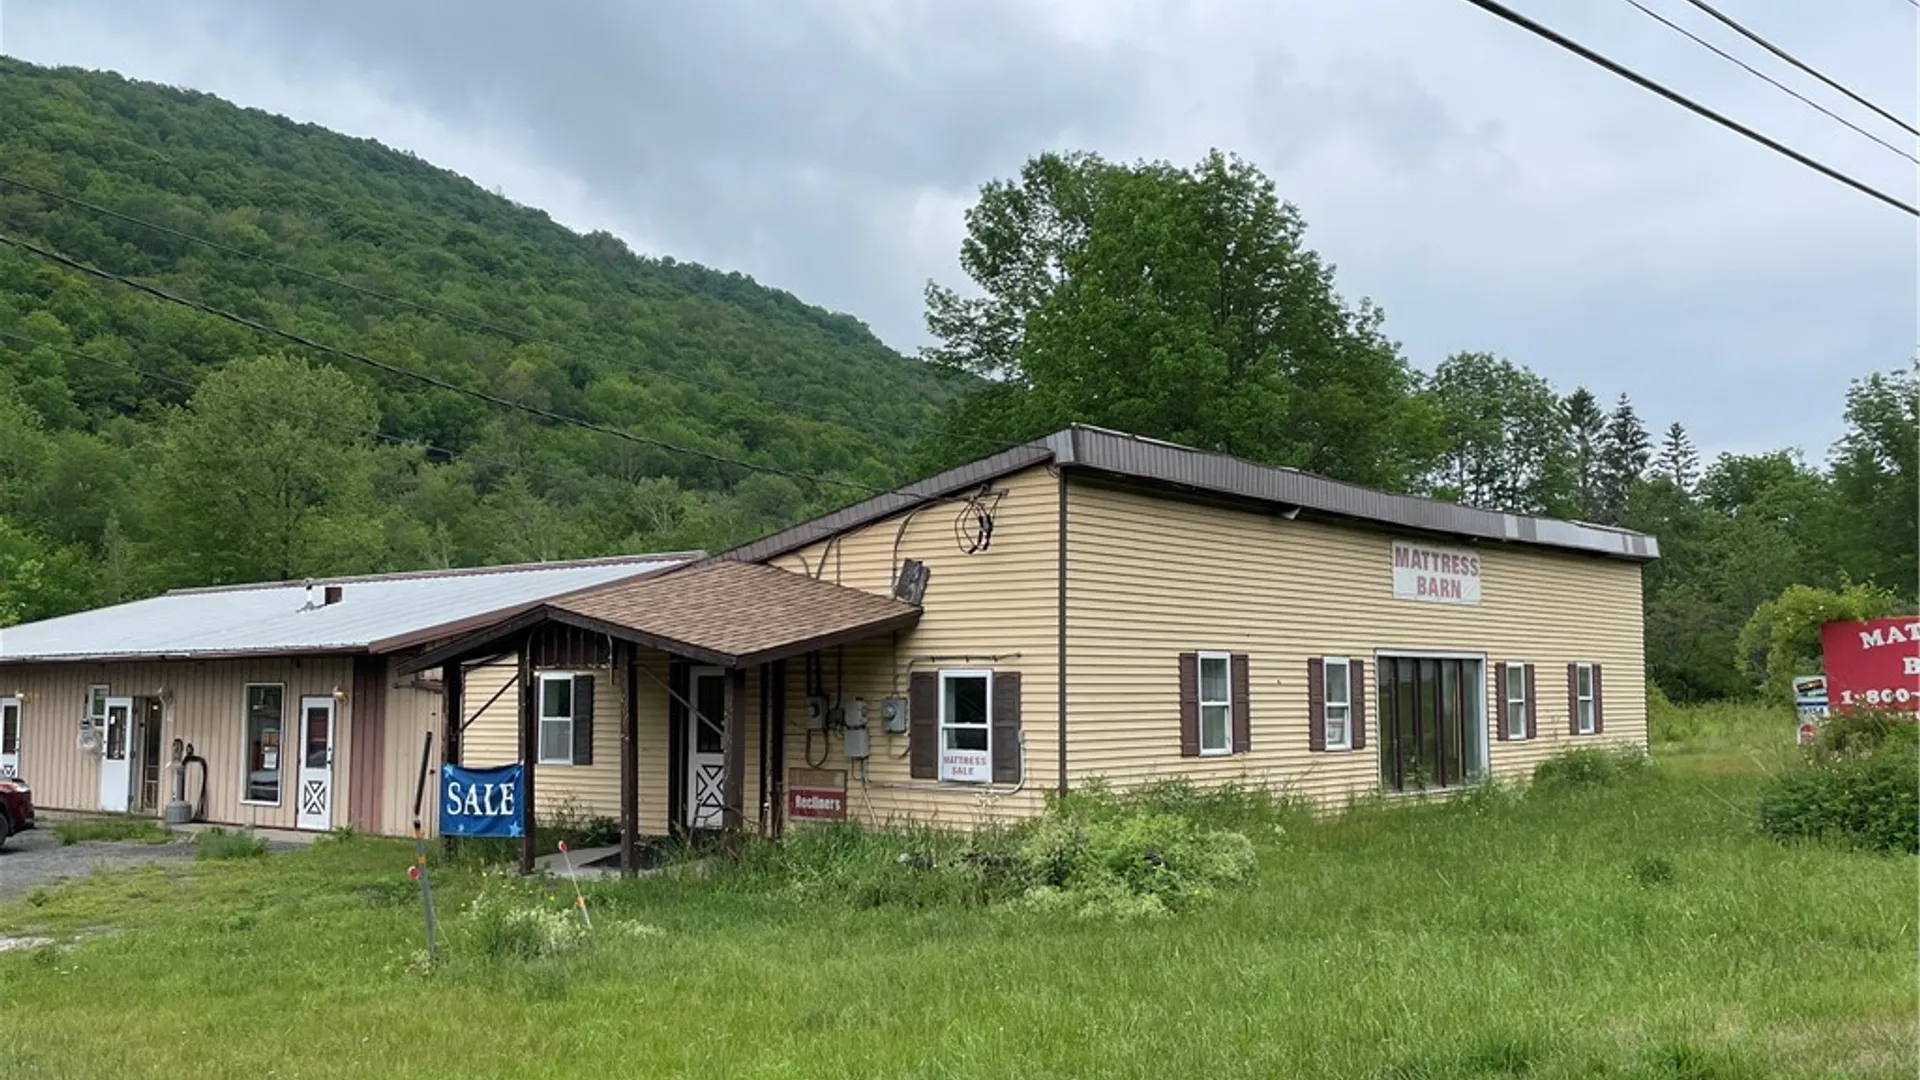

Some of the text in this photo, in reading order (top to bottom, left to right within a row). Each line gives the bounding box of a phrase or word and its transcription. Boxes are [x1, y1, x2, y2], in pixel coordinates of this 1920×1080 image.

[1395, 546, 1479, 577] MATTRESS
[1417, 576, 1461, 599] BARN
[943, 755, 987, 766] MATTRESS
[952, 766, 974, 776] SALE
[446, 782, 516, 816] SALE
[795, 795, 841, 811] Recliners
